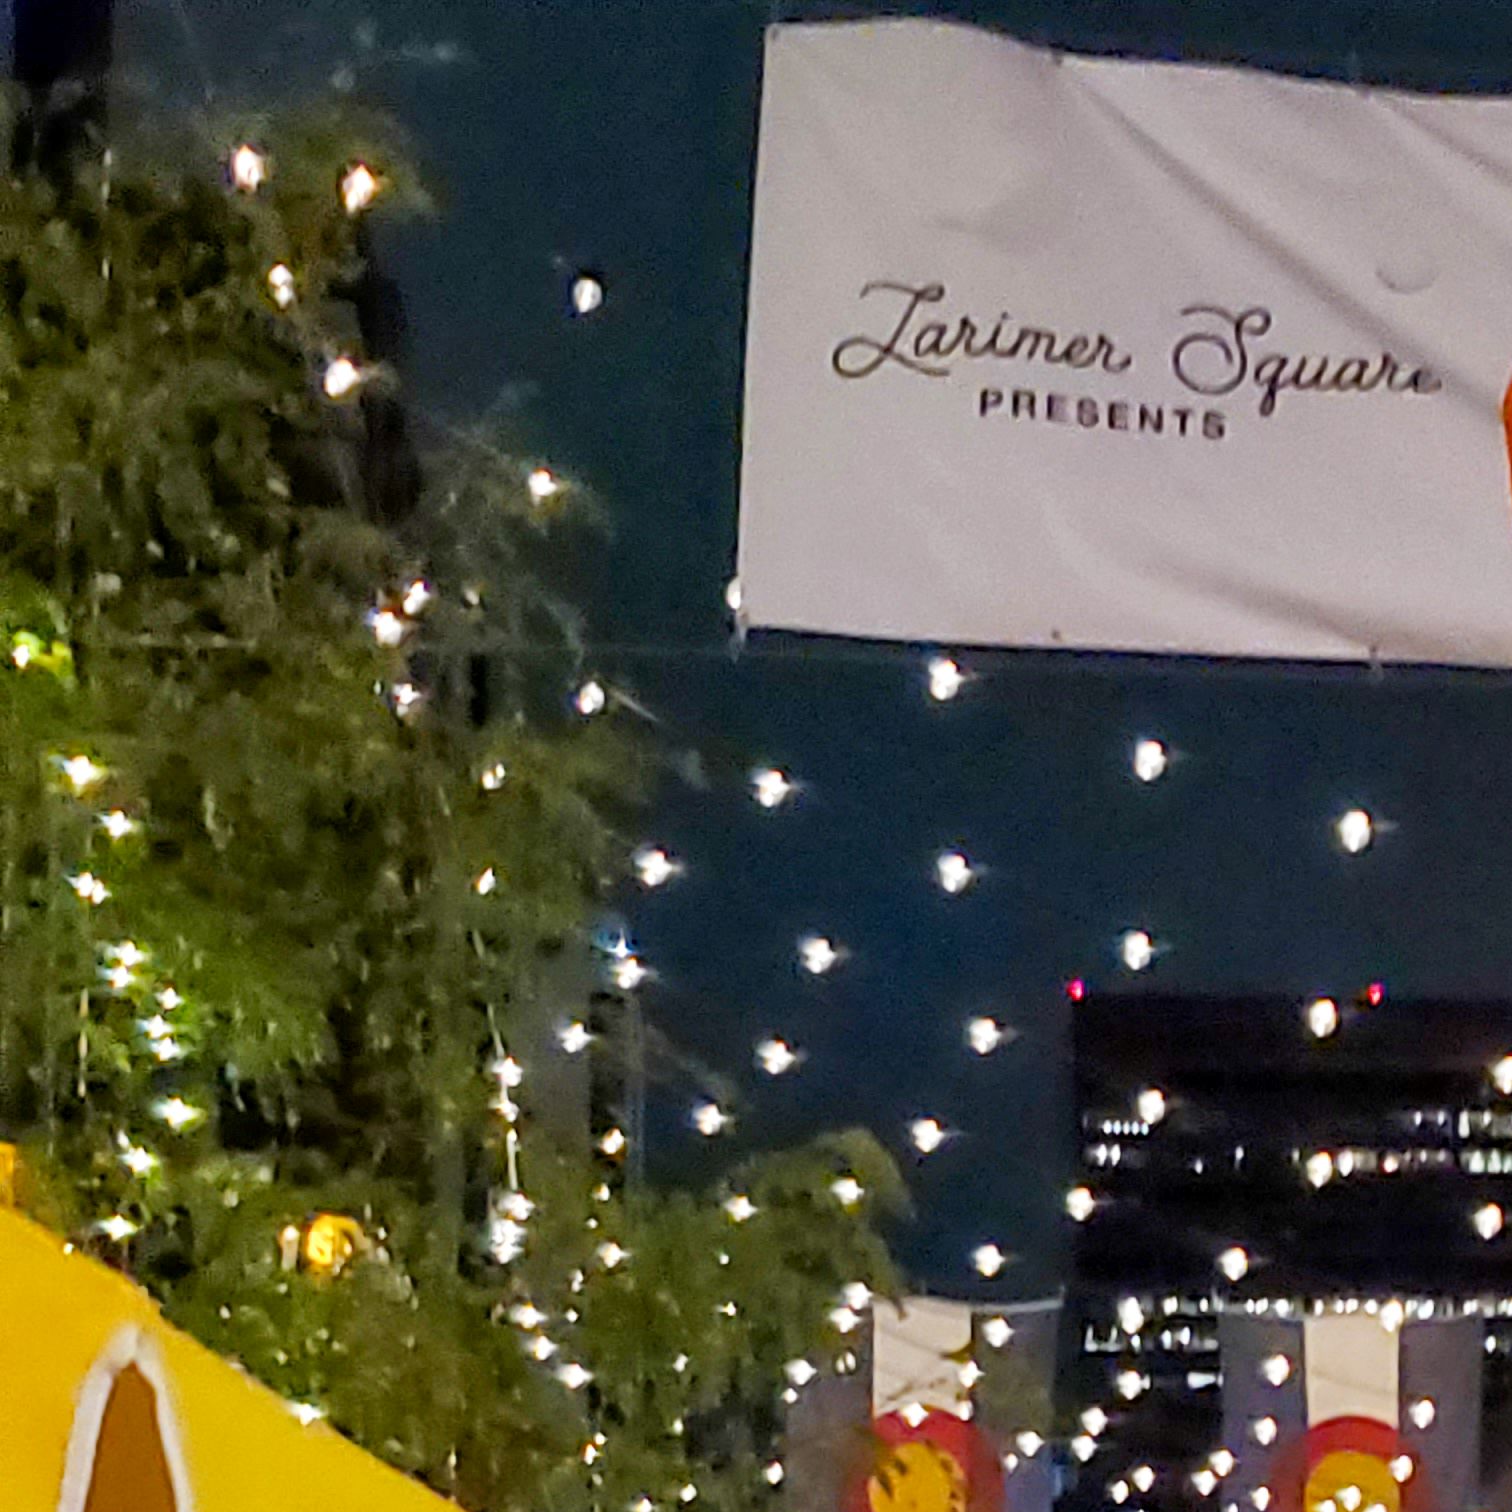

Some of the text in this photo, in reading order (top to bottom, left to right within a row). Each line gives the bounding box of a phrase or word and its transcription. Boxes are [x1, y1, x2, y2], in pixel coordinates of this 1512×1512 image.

[832, 279, 1443, 418] Larimer Square
[978, 387, 1226, 441] PRESENTS
